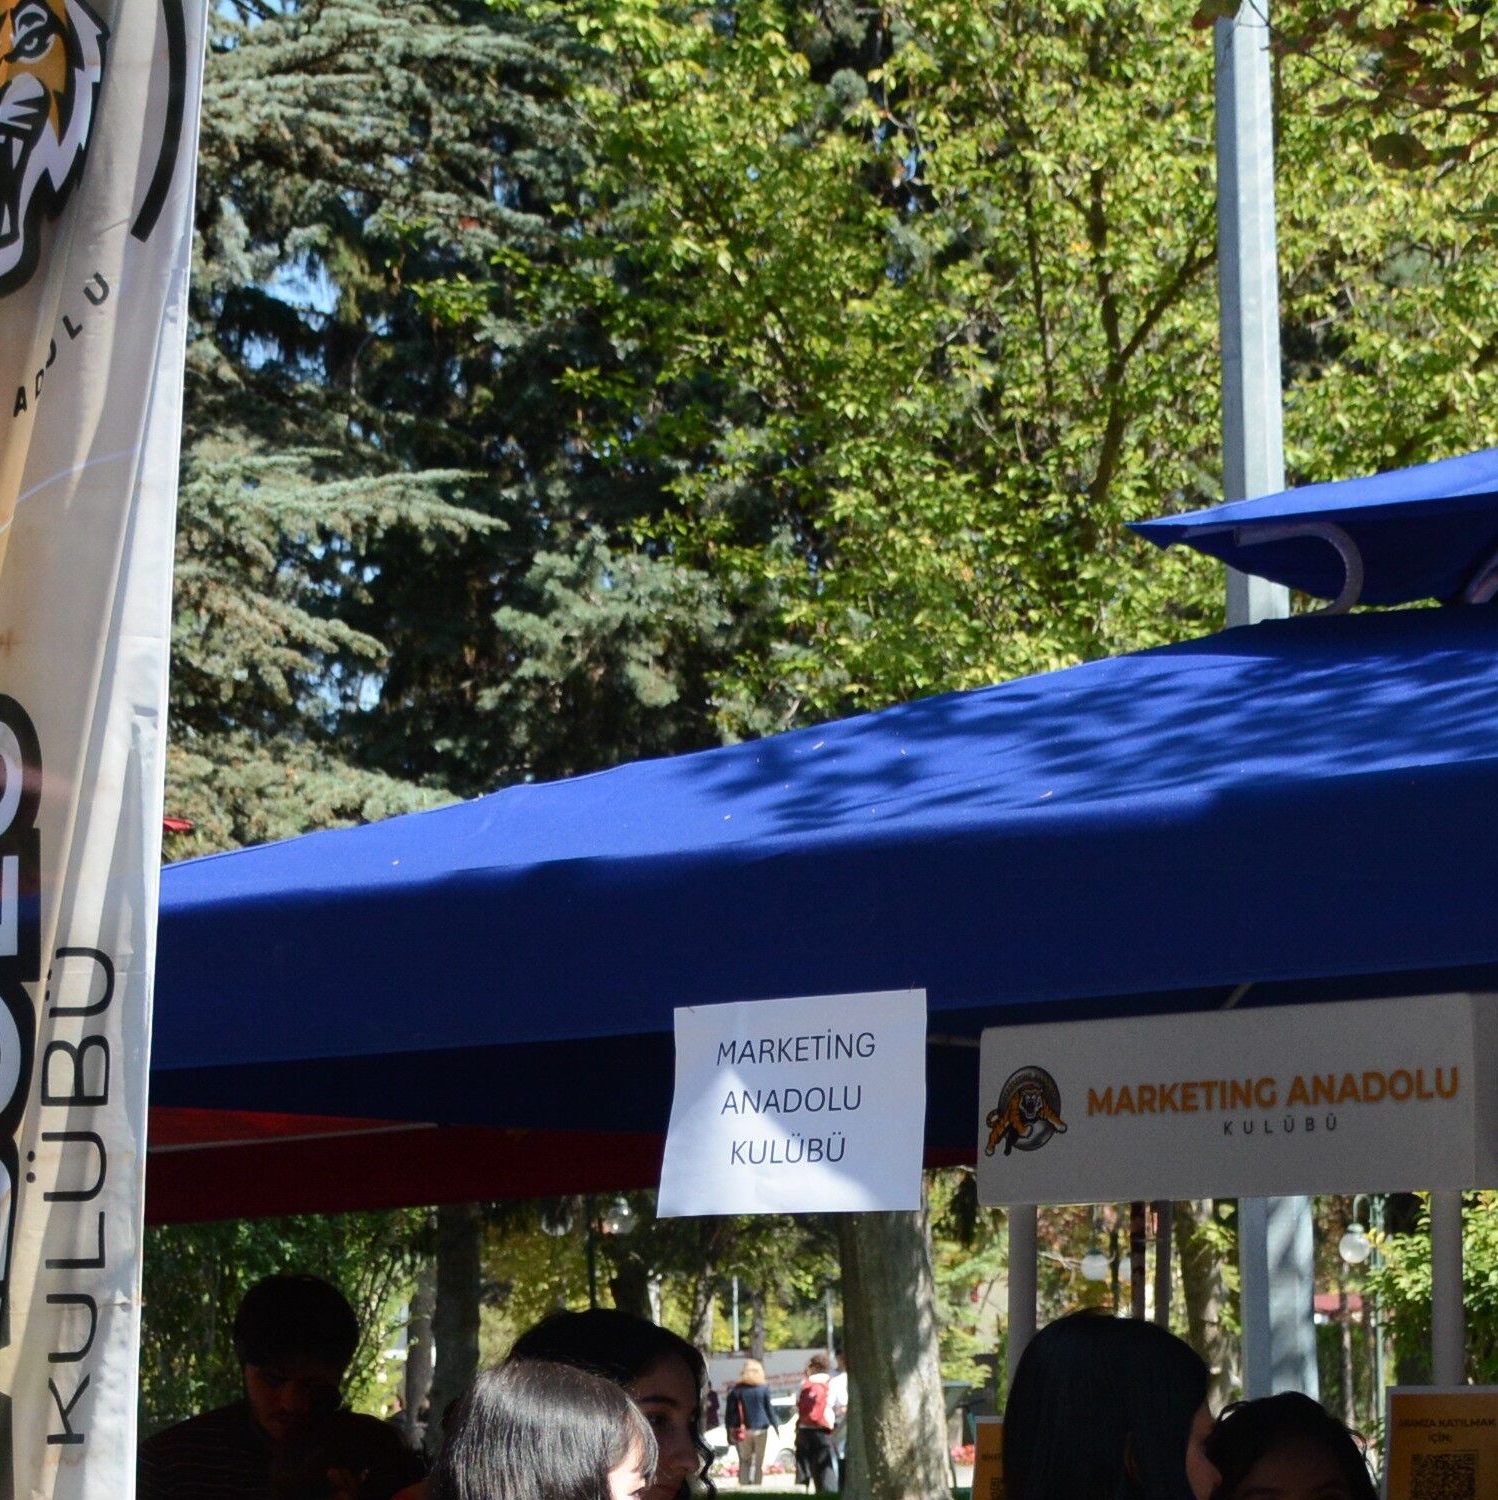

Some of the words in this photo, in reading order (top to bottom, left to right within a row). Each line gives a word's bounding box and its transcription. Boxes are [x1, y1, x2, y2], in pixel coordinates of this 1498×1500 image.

[716, 1029, 876, 1066] MARKETİNG
[721, 1085, 862, 1115] ANADOLU
[1086, 1076, 1277, 1117] MARKETING
[1289, 1066, 1459, 1105] ANADOLU
[1223, 1113, 1338, 1136] KULÜBÜ
[730, 1131, 846, 1165] KULÜBÜ
[27, 945, 116, 1446] KULÜBÜ
